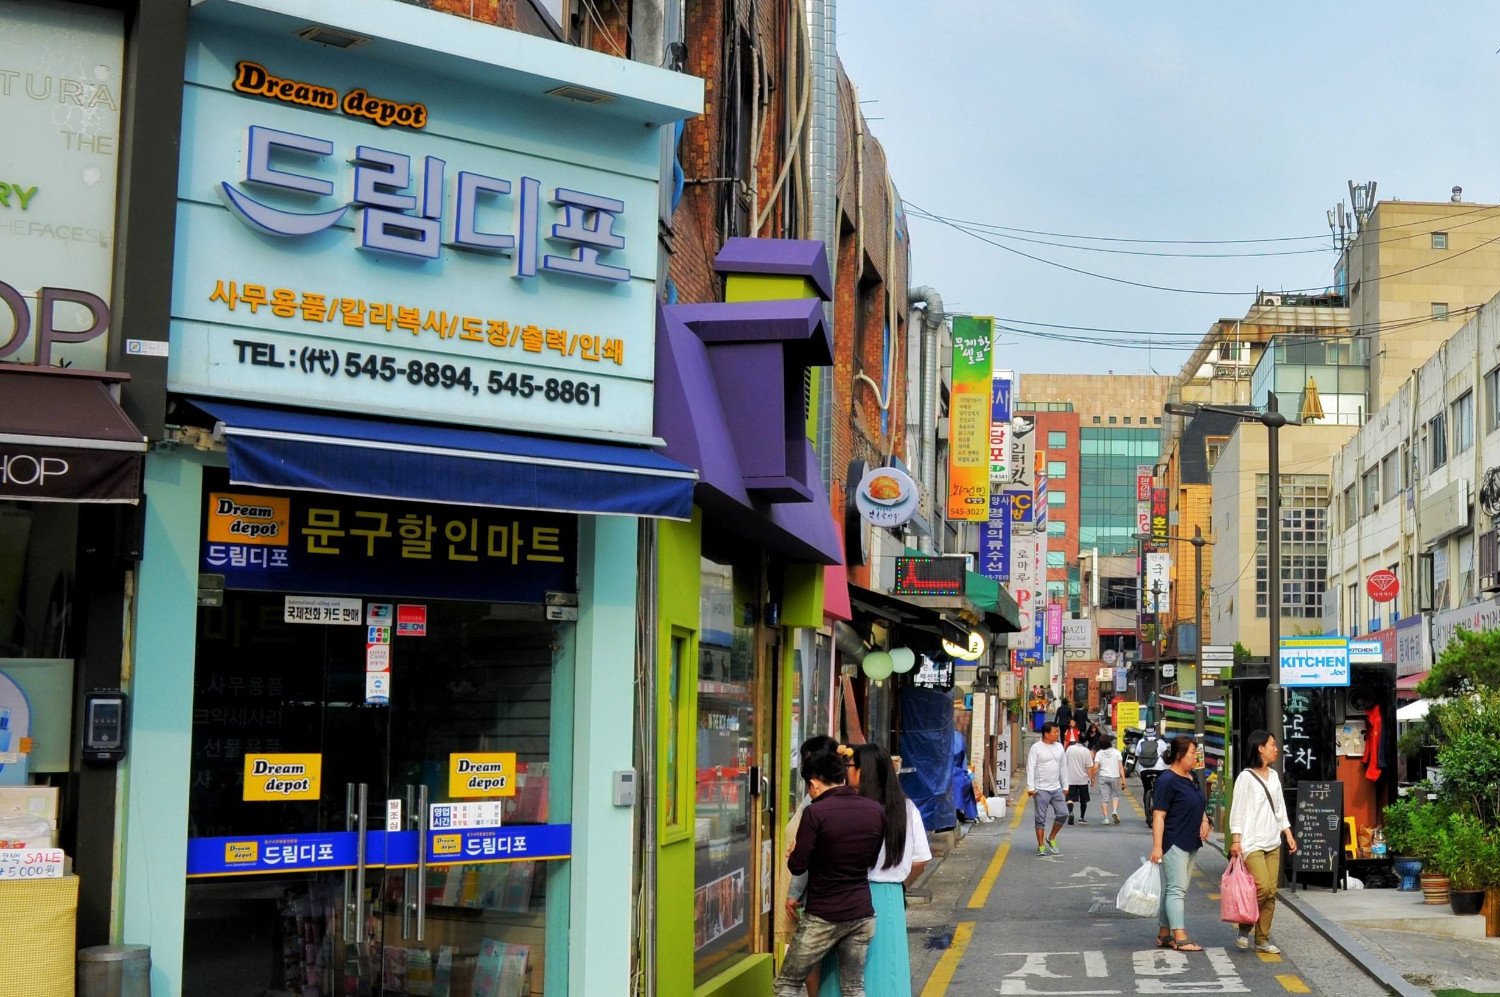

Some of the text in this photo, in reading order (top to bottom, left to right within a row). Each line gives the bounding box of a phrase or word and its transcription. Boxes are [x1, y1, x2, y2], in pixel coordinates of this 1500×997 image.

[235, 62, 427, 129] Dream depot
[60, 130, 113, 155] THE
[221, 125, 631, 282] 드림디포
[345, 352, 480, 397] 545-8894,
[486, 370, 602, 407] 545-8861
[217, 499, 273, 518] Dream
[230, 519, 279, 537] depot
[301, 507, 565, 565] 문구할인마트
[205, 546, 289, 569] 드림디포
[288, 606, 359, 623] 국제전화 카드 판매
[399, 622, 425, 631] SEOM
[1281, 656, 1346, 668] KITCHEN
[252, 759, 305, 776] Dream
[457, 759, 502, 774] Dream
[264, 776, 309, 793] depot
[467, 775, 506, 790] depot
[433, 807, 451, 817] 영업
[433, 817, 451, 827] 시간
[262, 843, 334, 865] 드림디포
[465, 836, 527, 855] 드림디포
[24, 851, 61, 865] SALE
